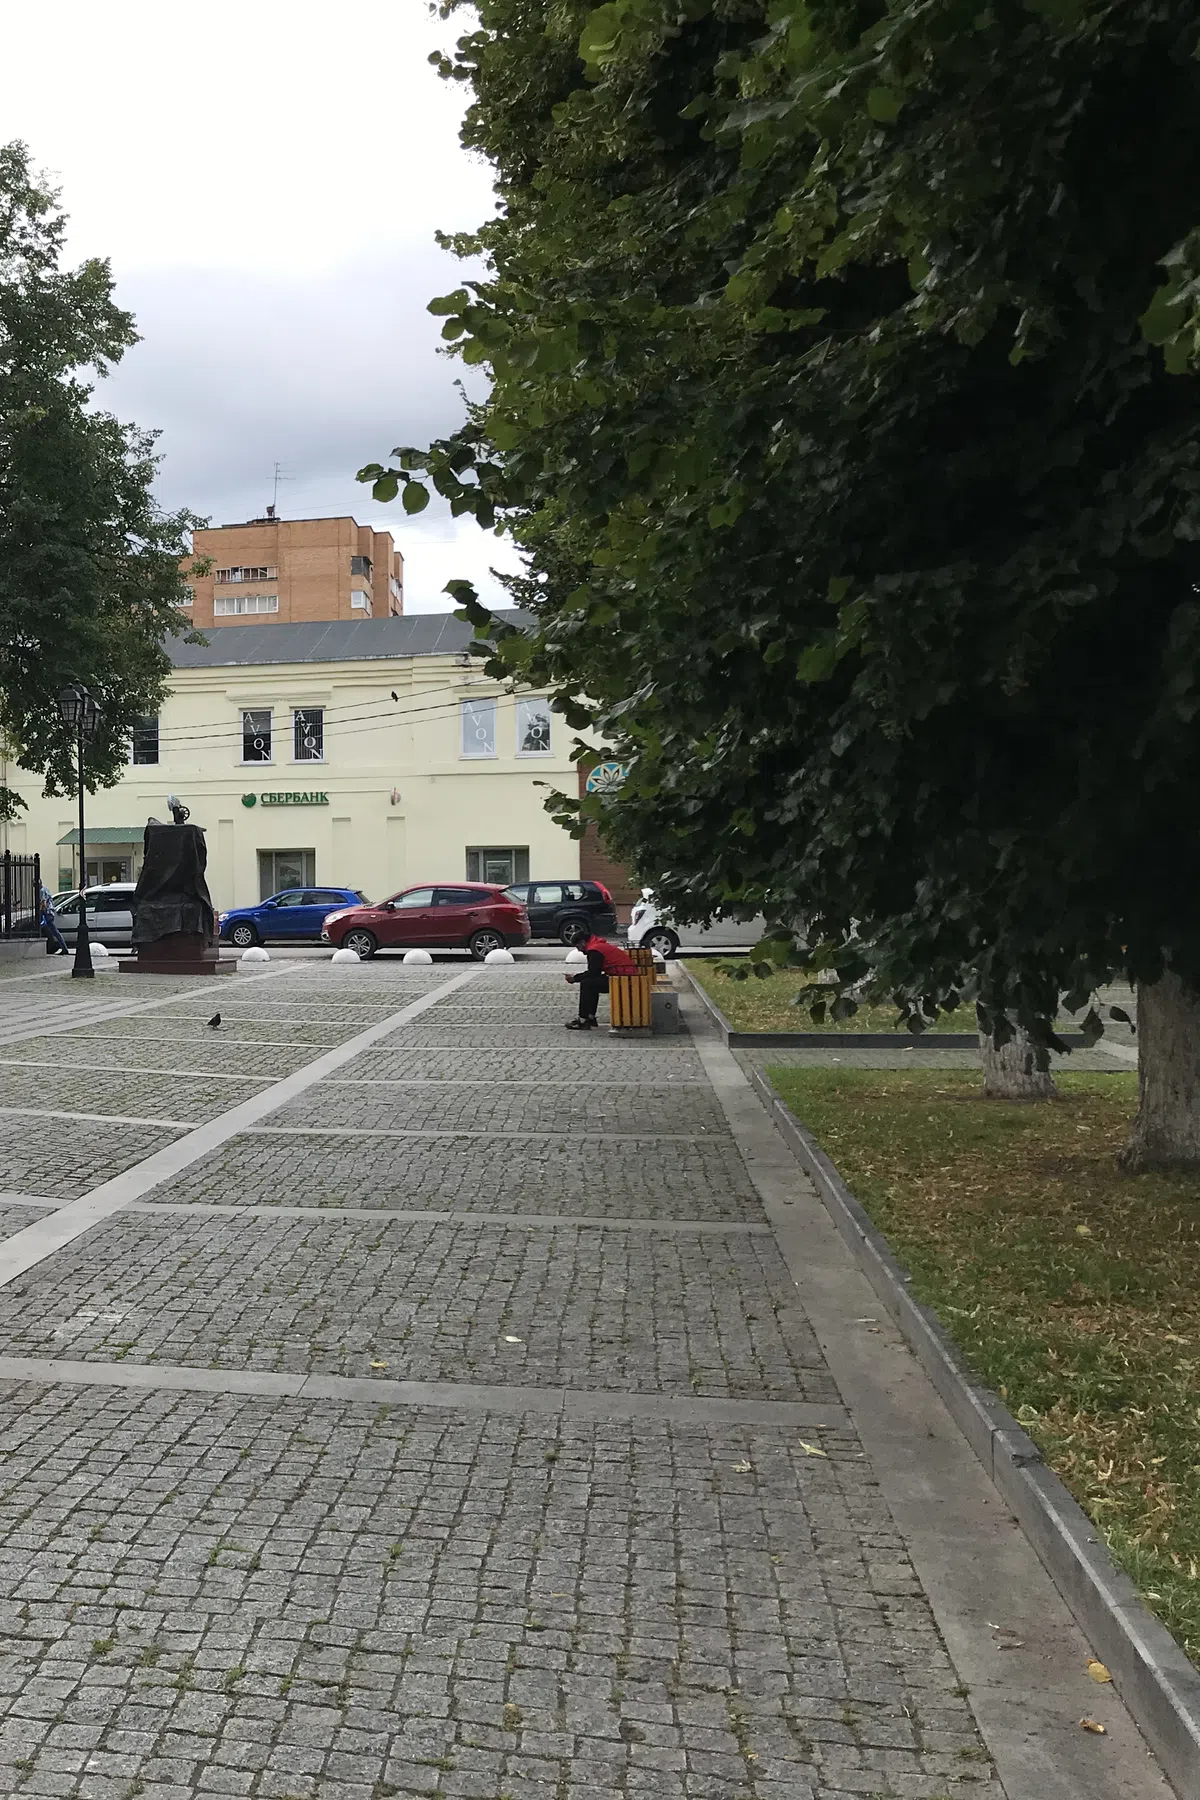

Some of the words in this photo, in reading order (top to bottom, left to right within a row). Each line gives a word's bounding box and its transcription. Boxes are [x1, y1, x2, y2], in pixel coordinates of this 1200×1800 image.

[244, 713, 271, 761] AVON
[295, 711, 323, 759] AVON
[464, 703, 494, 752] AVON
[520, 702, 550, 750] AVON
[261, 792, 329, 803] СБЕРБАНК
